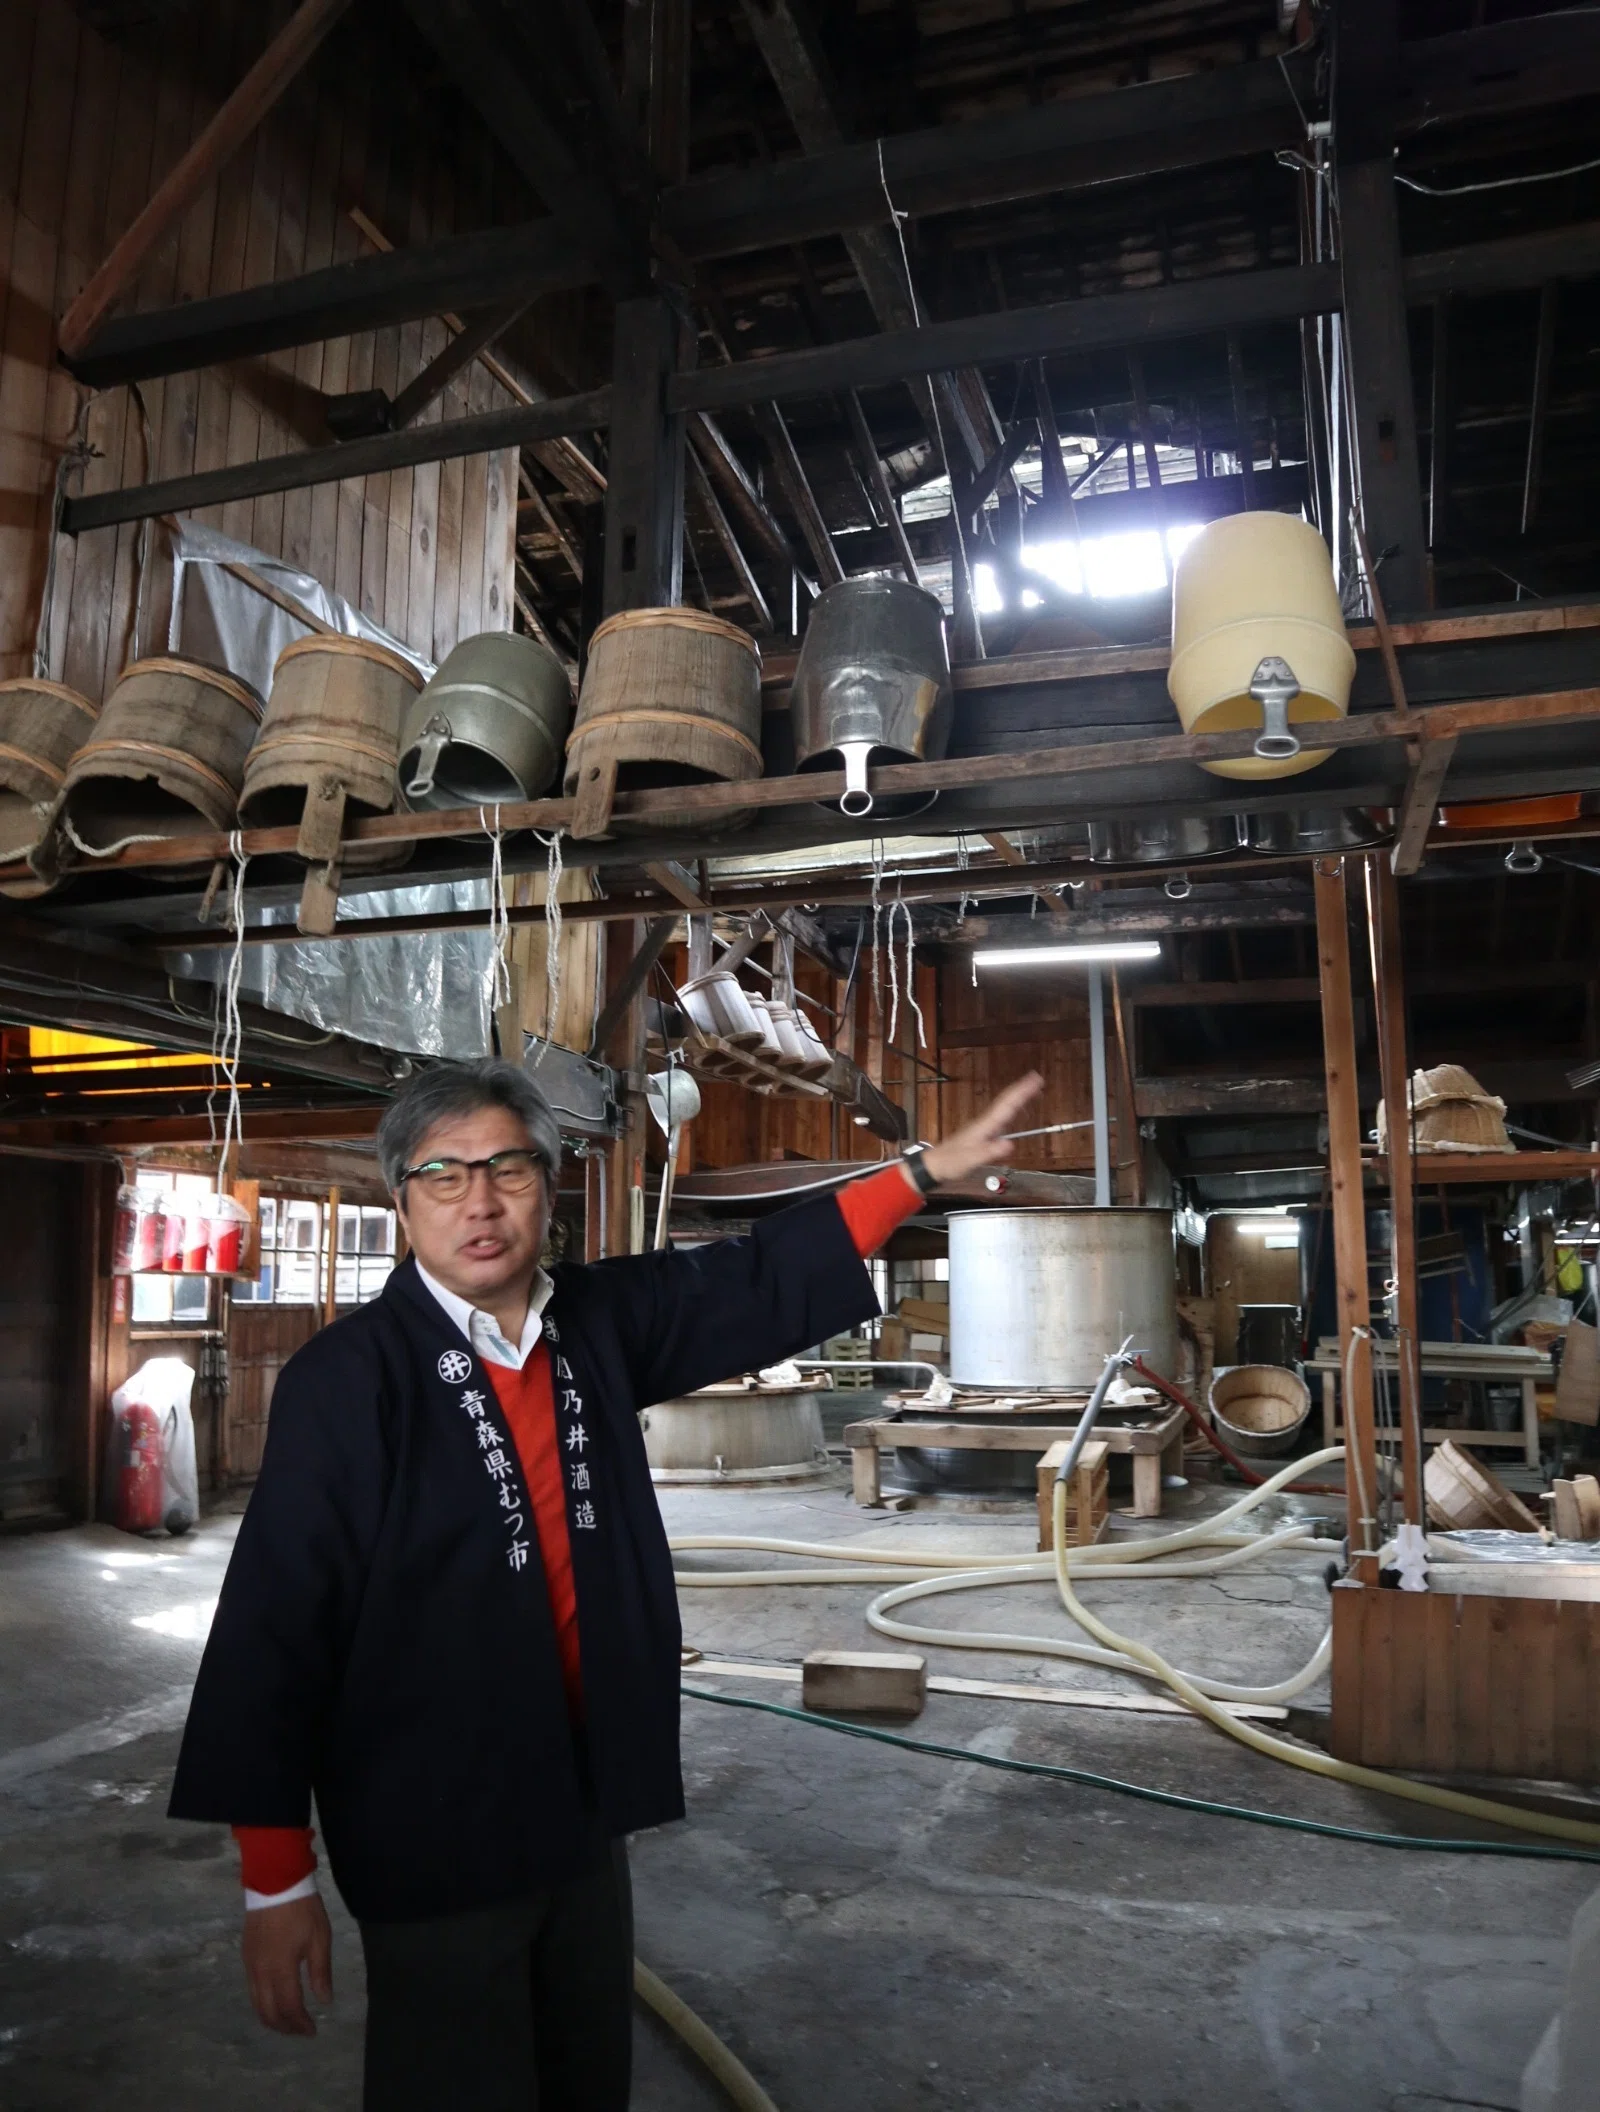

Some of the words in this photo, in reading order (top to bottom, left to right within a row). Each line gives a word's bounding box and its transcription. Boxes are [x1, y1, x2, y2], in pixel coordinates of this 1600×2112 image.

[459, 1390, 529, 1571] 青森県むつ市
